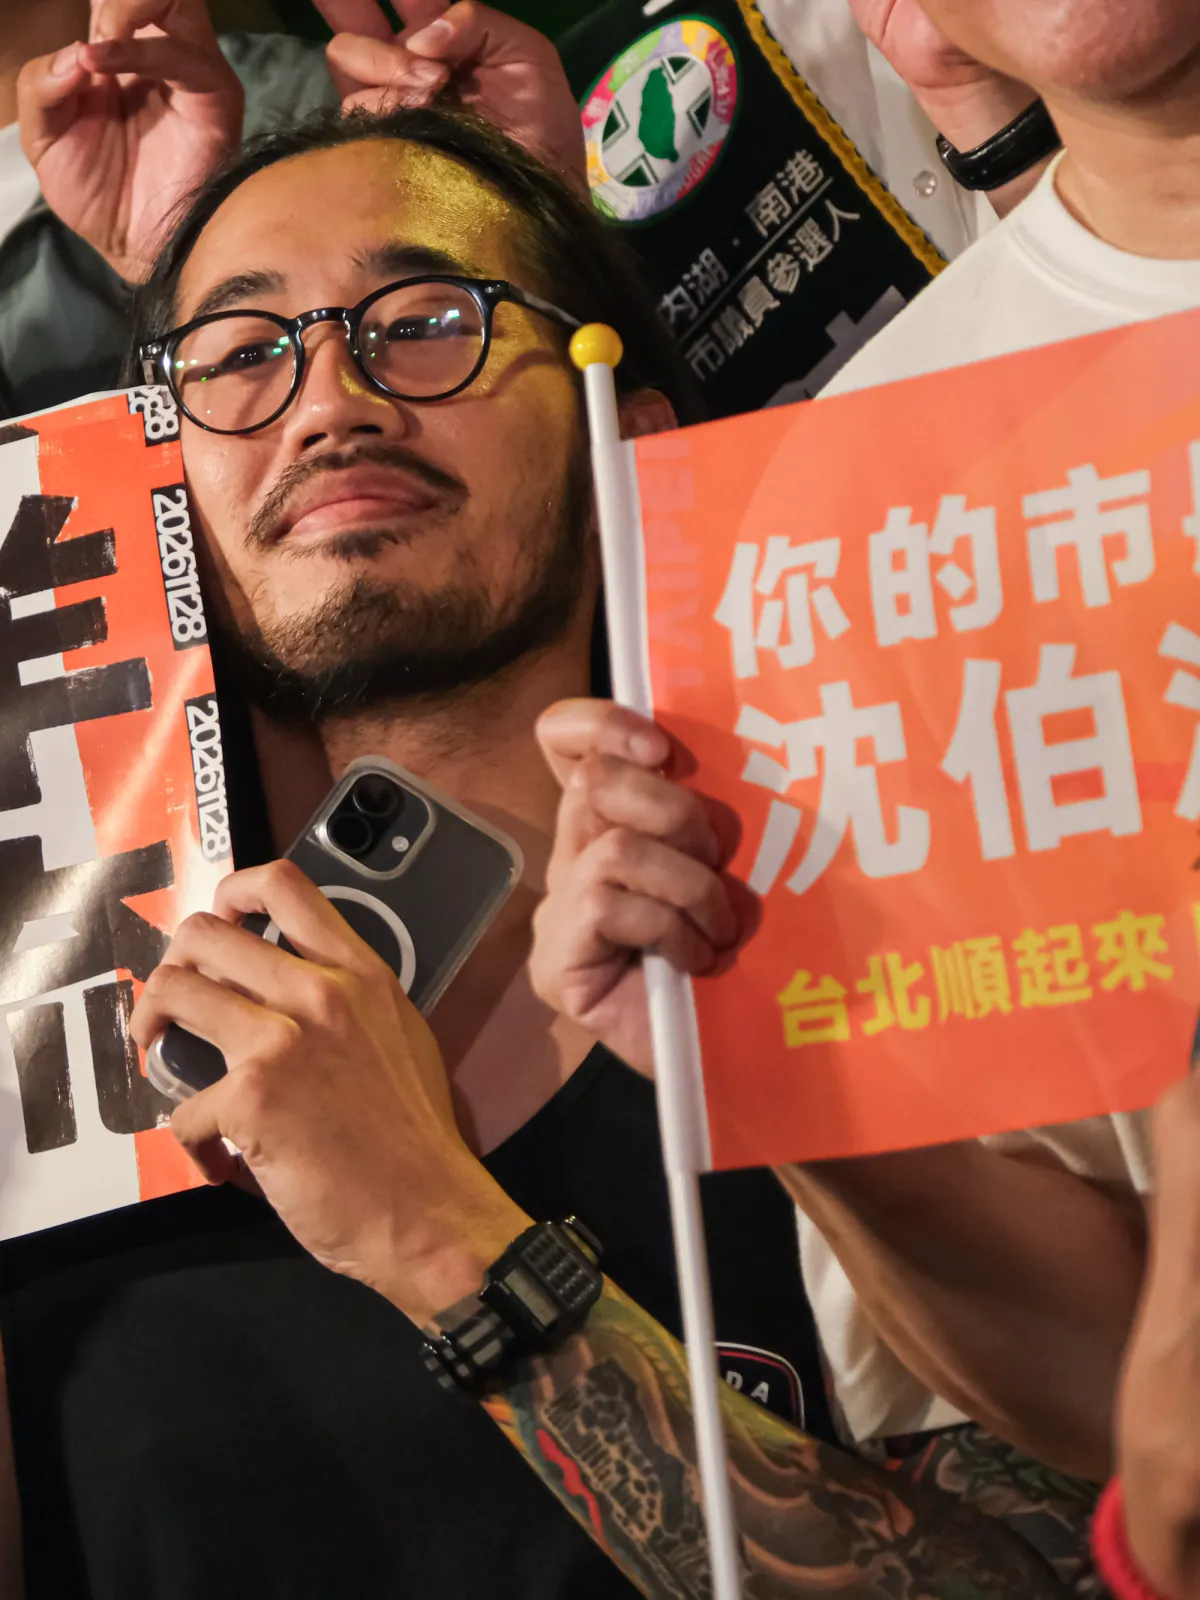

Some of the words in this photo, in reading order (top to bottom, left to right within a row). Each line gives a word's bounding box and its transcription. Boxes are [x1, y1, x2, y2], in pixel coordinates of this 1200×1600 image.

[153, 489, 207, 642] 20261128
[713, 440, 1200, 680] 你的市
[186, 700, 230, 858] 20261128
[734, 621, 1200, 896] 沈伯
